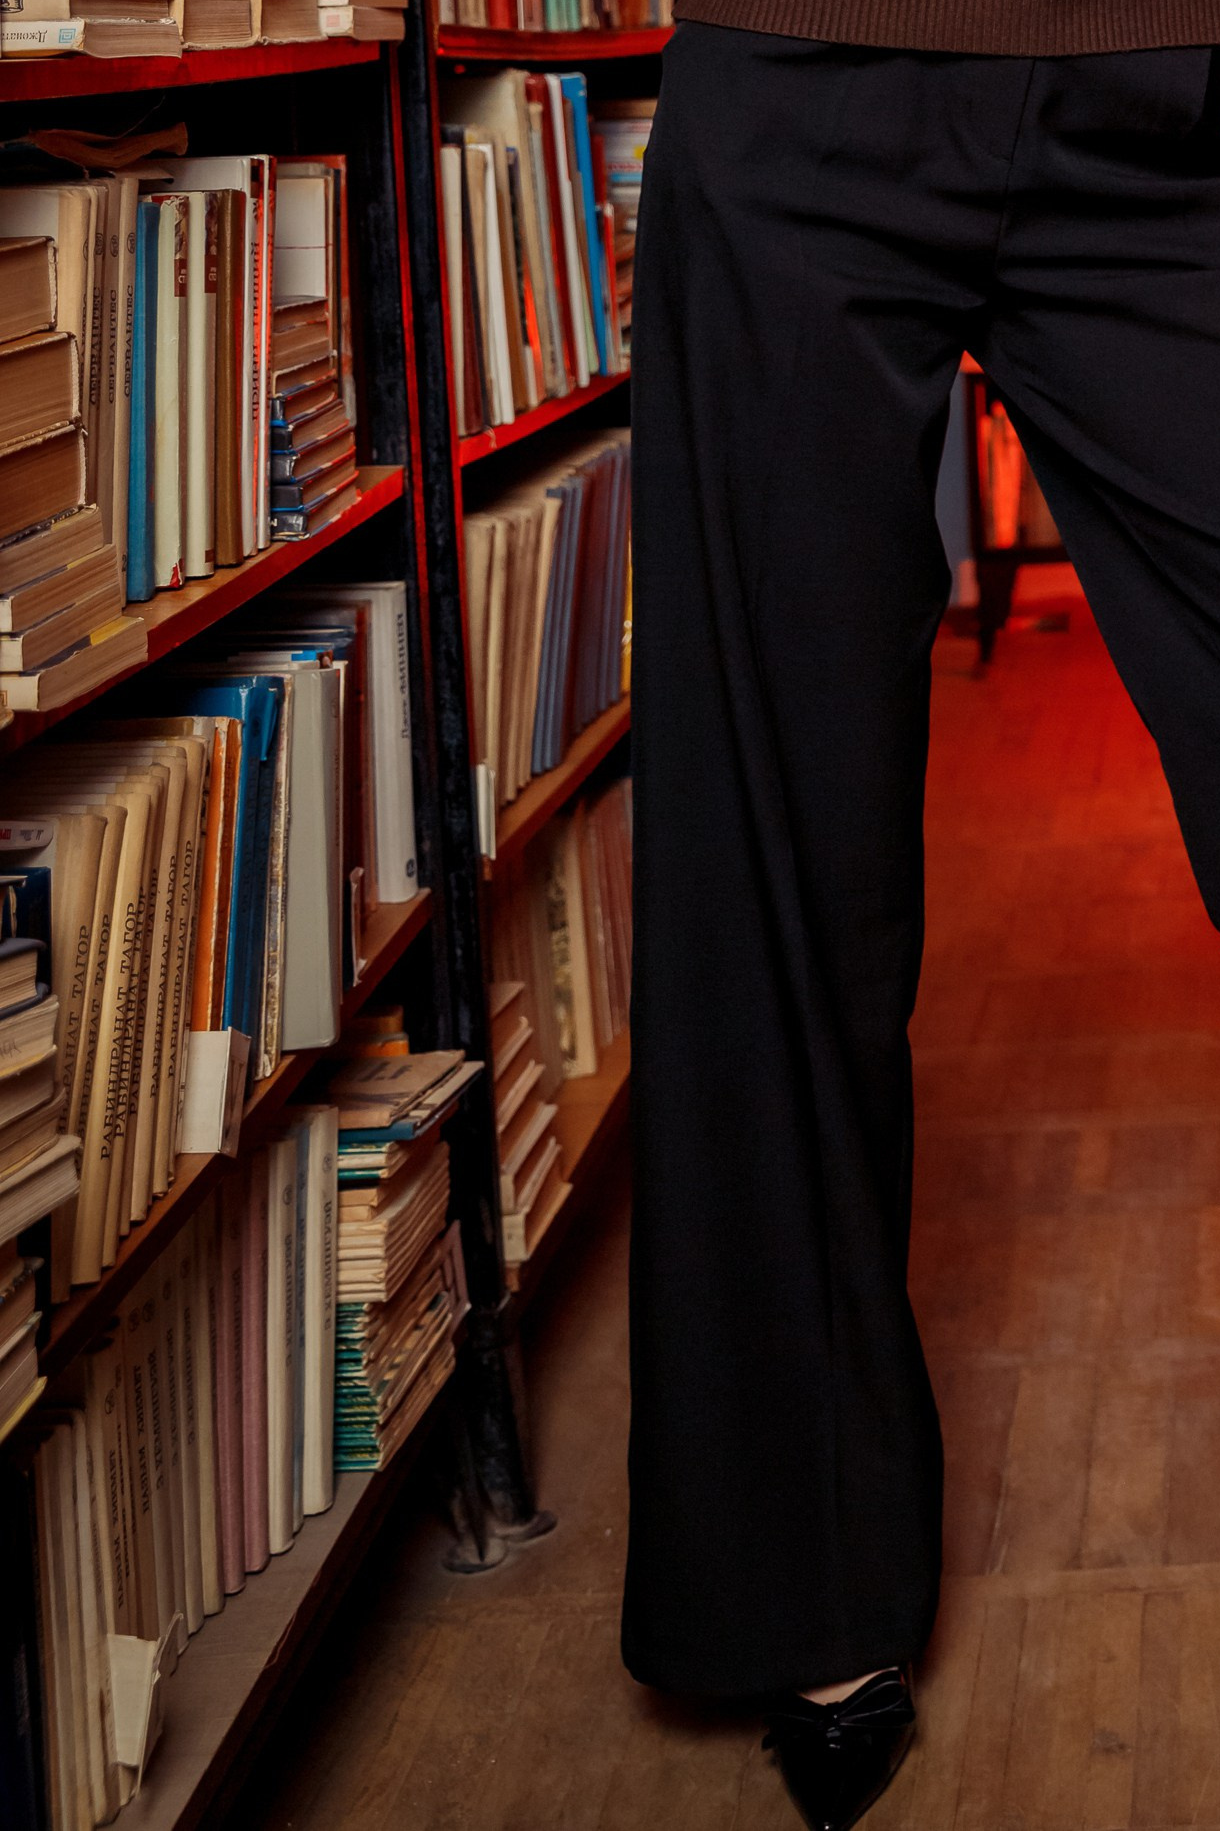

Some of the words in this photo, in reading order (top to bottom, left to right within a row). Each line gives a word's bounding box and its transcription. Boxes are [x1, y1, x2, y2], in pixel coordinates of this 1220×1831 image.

[108, 290, 116, 403] СЕРВАНТЕС
[124, 285, 133, 397] СЕРВАНТЕС
[181, 840, 194, 906] ТАГОР
[72, 925, 90, 999] ТАГОР
[95, 914, 110, 986] ТАГОР
[101, 986, 126, 1160] РАБИНДРАНАТ
[120, 902, 136, 973] ТАГОР
[114, 968, 139, 1137] РАБИНДРАНАТ
[133, 1364, 145, 1436] ХИКМЕТ
[109, 1449, 119, 1524] ХИКМЕТ
